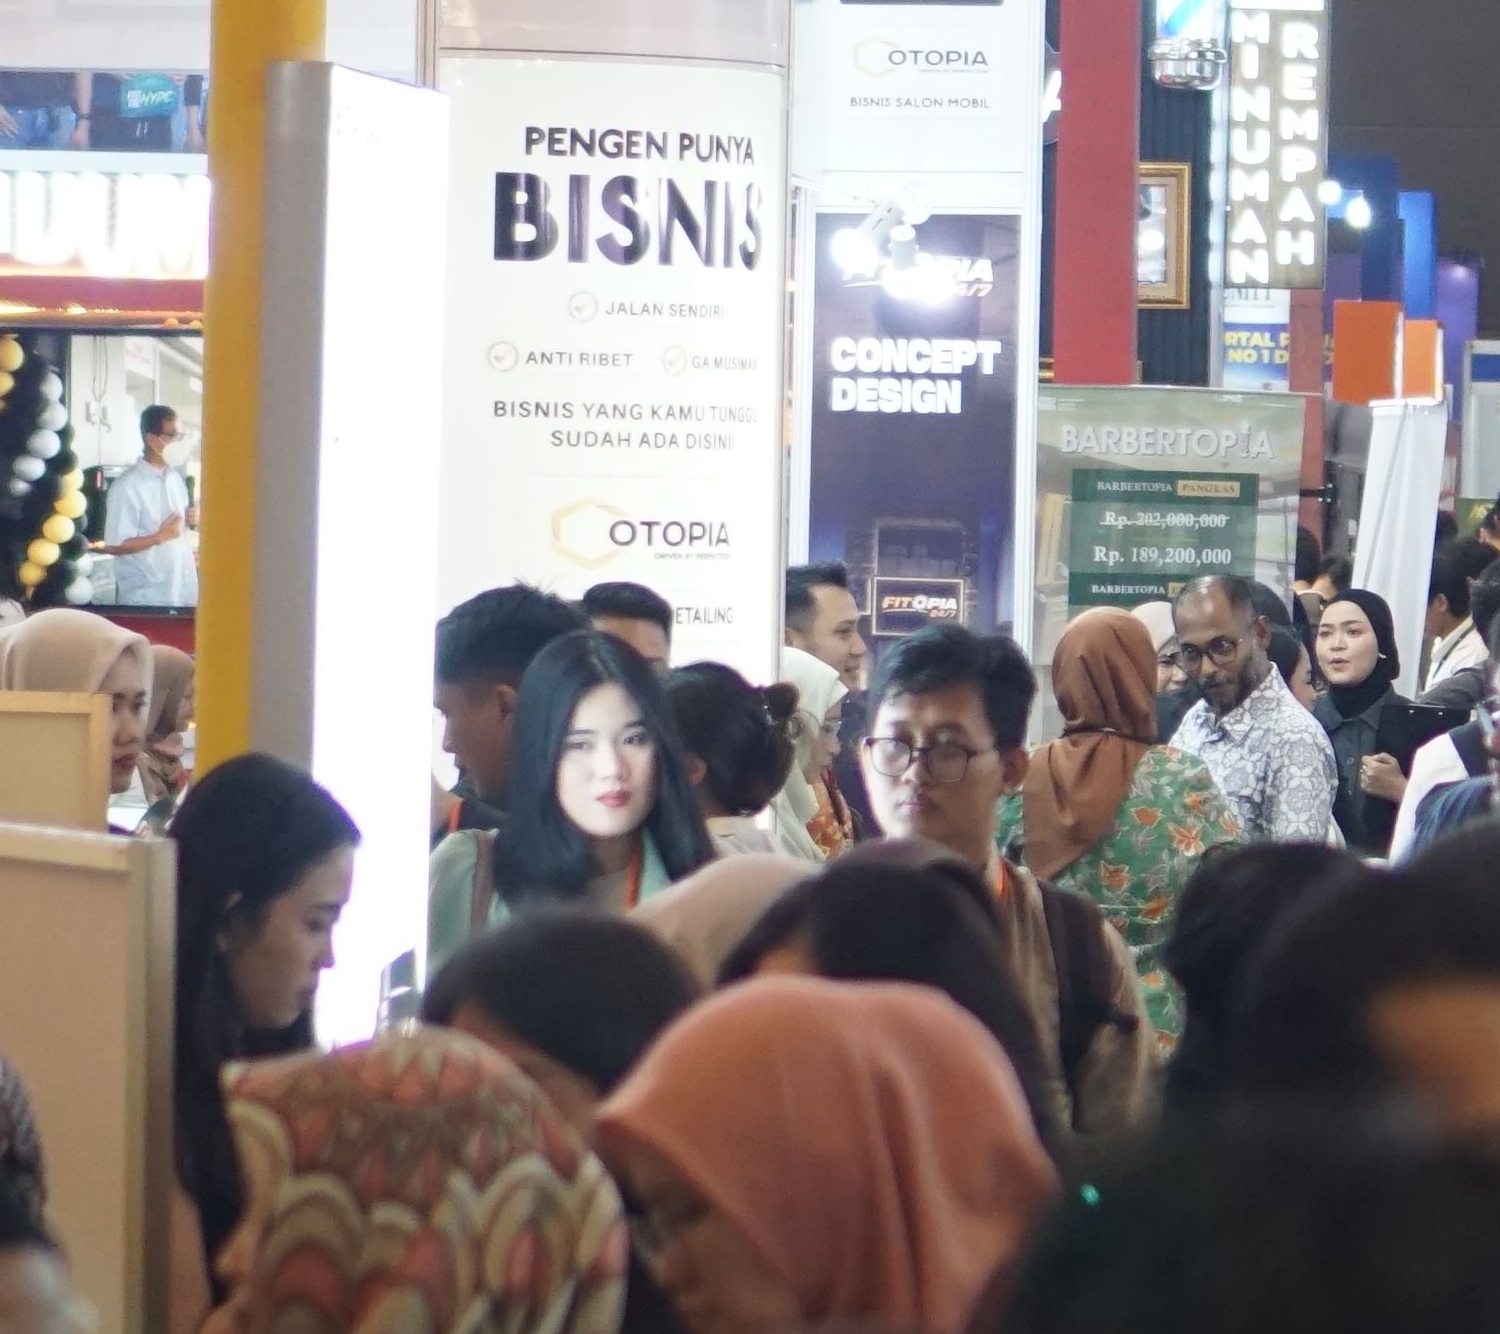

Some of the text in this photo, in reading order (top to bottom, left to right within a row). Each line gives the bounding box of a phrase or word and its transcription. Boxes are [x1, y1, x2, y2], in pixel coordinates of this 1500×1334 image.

[888, 49, 988, 66] OTOPIA
[850, 97, 990, 109] BISNIS SALON MOBIL
[525, 127, 754, 165] PENGEN PUNYA
[1230, 12, 1270, 284] MINUMAN
[1279, 22, 1319, 266] REMPAH
[493, 172, 762, 271] BISNIS
[606, 302, 724, 318] JALAN SENDIRI
[526, 351, 572, 365] ANTI
[580, 352, 633, 367] RIBET
[692, 356, 709, 369] GA
[832, 337, 1001, 376] CONCEPT
[832, 378, 962, 415] DESIGN
[494, 401, 758, 423] BISNIS YANG KAMU TUNGGU
[551, 430, 631, 448] SUDAH
[639, 432, 679, 449] ADA
[1061, 422, 1274, 459] BARBERTOPIA
[1097, 481, 1173, 492] BARBERTOPIA
[610, 520, 730, 547] OTOPIA
[1094, 546, 1232, 566] Rp. 189,200,000
[882, 595, 958, 610] FITOPIA
